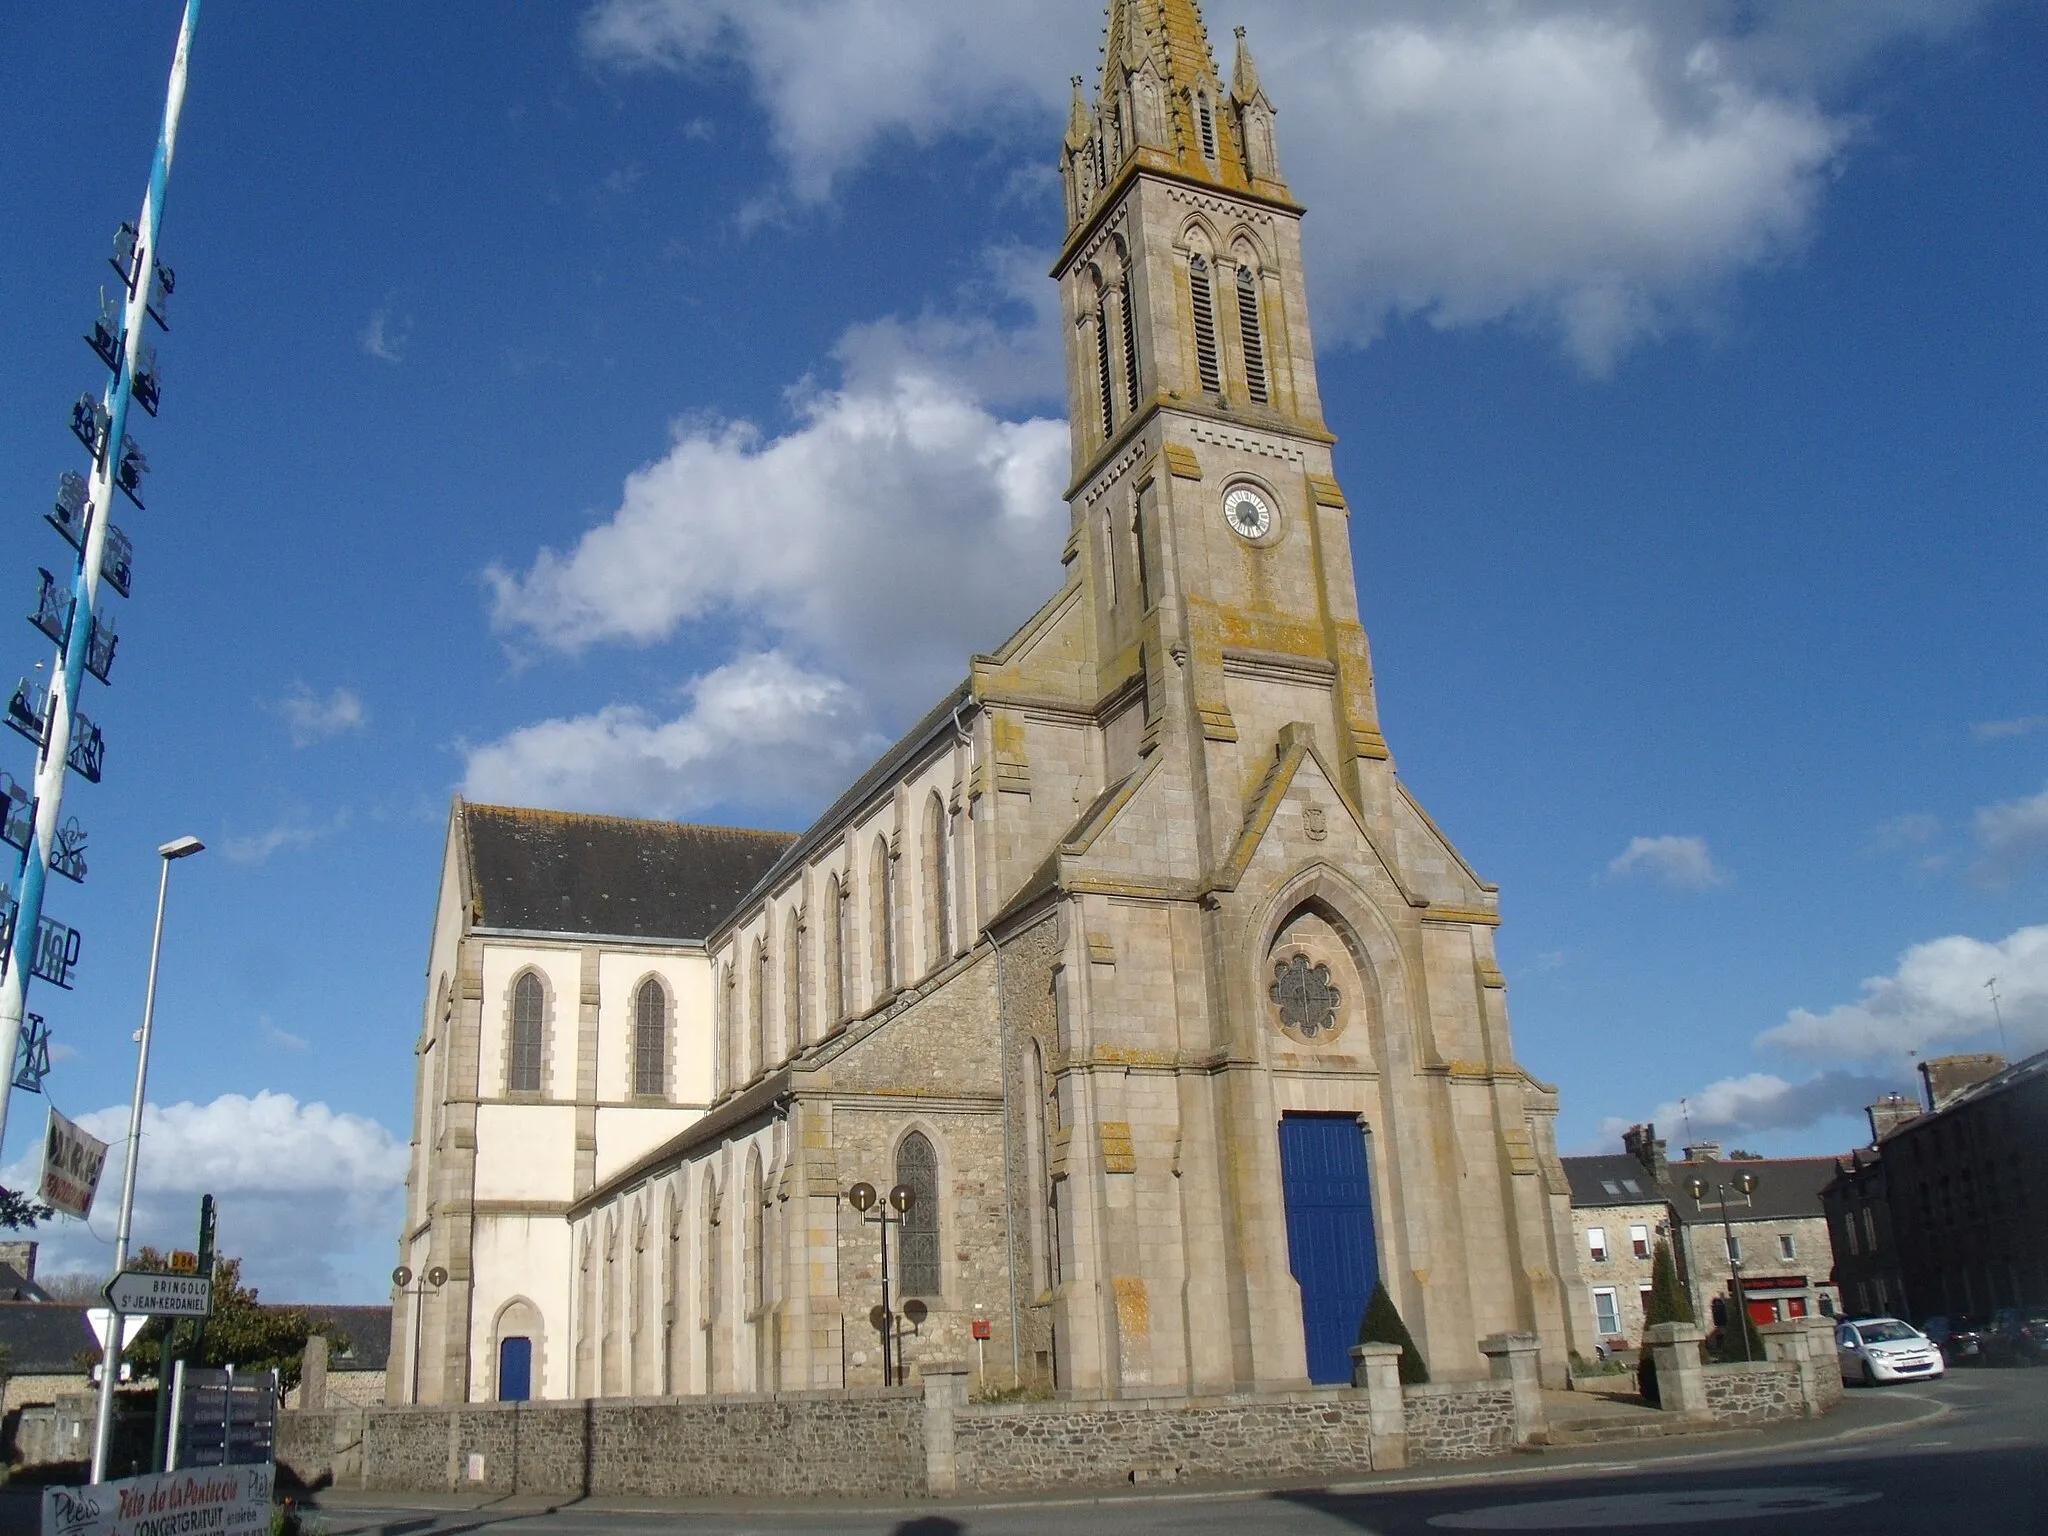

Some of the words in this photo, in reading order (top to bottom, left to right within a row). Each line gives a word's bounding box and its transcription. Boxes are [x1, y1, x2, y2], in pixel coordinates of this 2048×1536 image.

[172, 1255, 179, 1267] D
[181, 1255, 193, 1268] 84
[153, 1280, 207, 1296] BRINGOLO
[133, 1295, 206, 1311] JEAN-KERDANIEL
[148, 1480, 167, 1514] de
